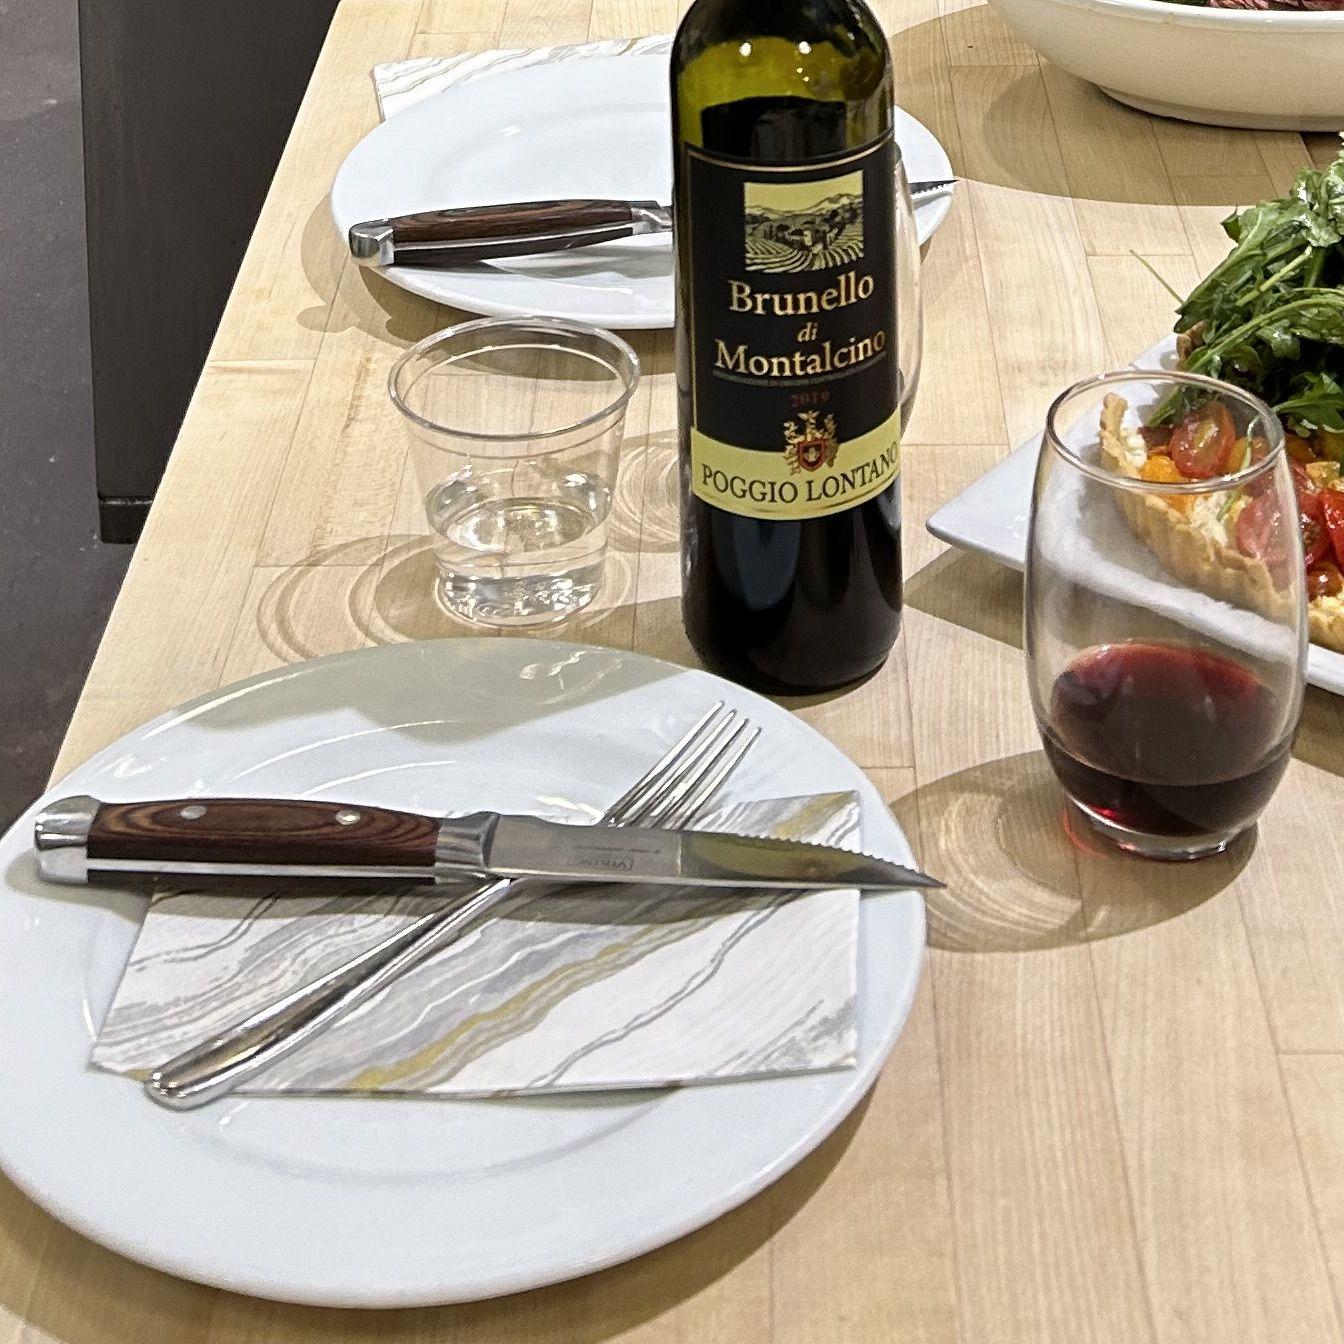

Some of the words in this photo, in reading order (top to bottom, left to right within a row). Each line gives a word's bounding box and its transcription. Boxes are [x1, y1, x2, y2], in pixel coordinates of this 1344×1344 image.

[728, 270, 875, 315] Brunello
[713, 330, 886, 377] Montalcino
[796, 321, 819, 343] di
[702, 464, 798, 503] POGGIO
[806, 441, 898, 502] LONTANO
